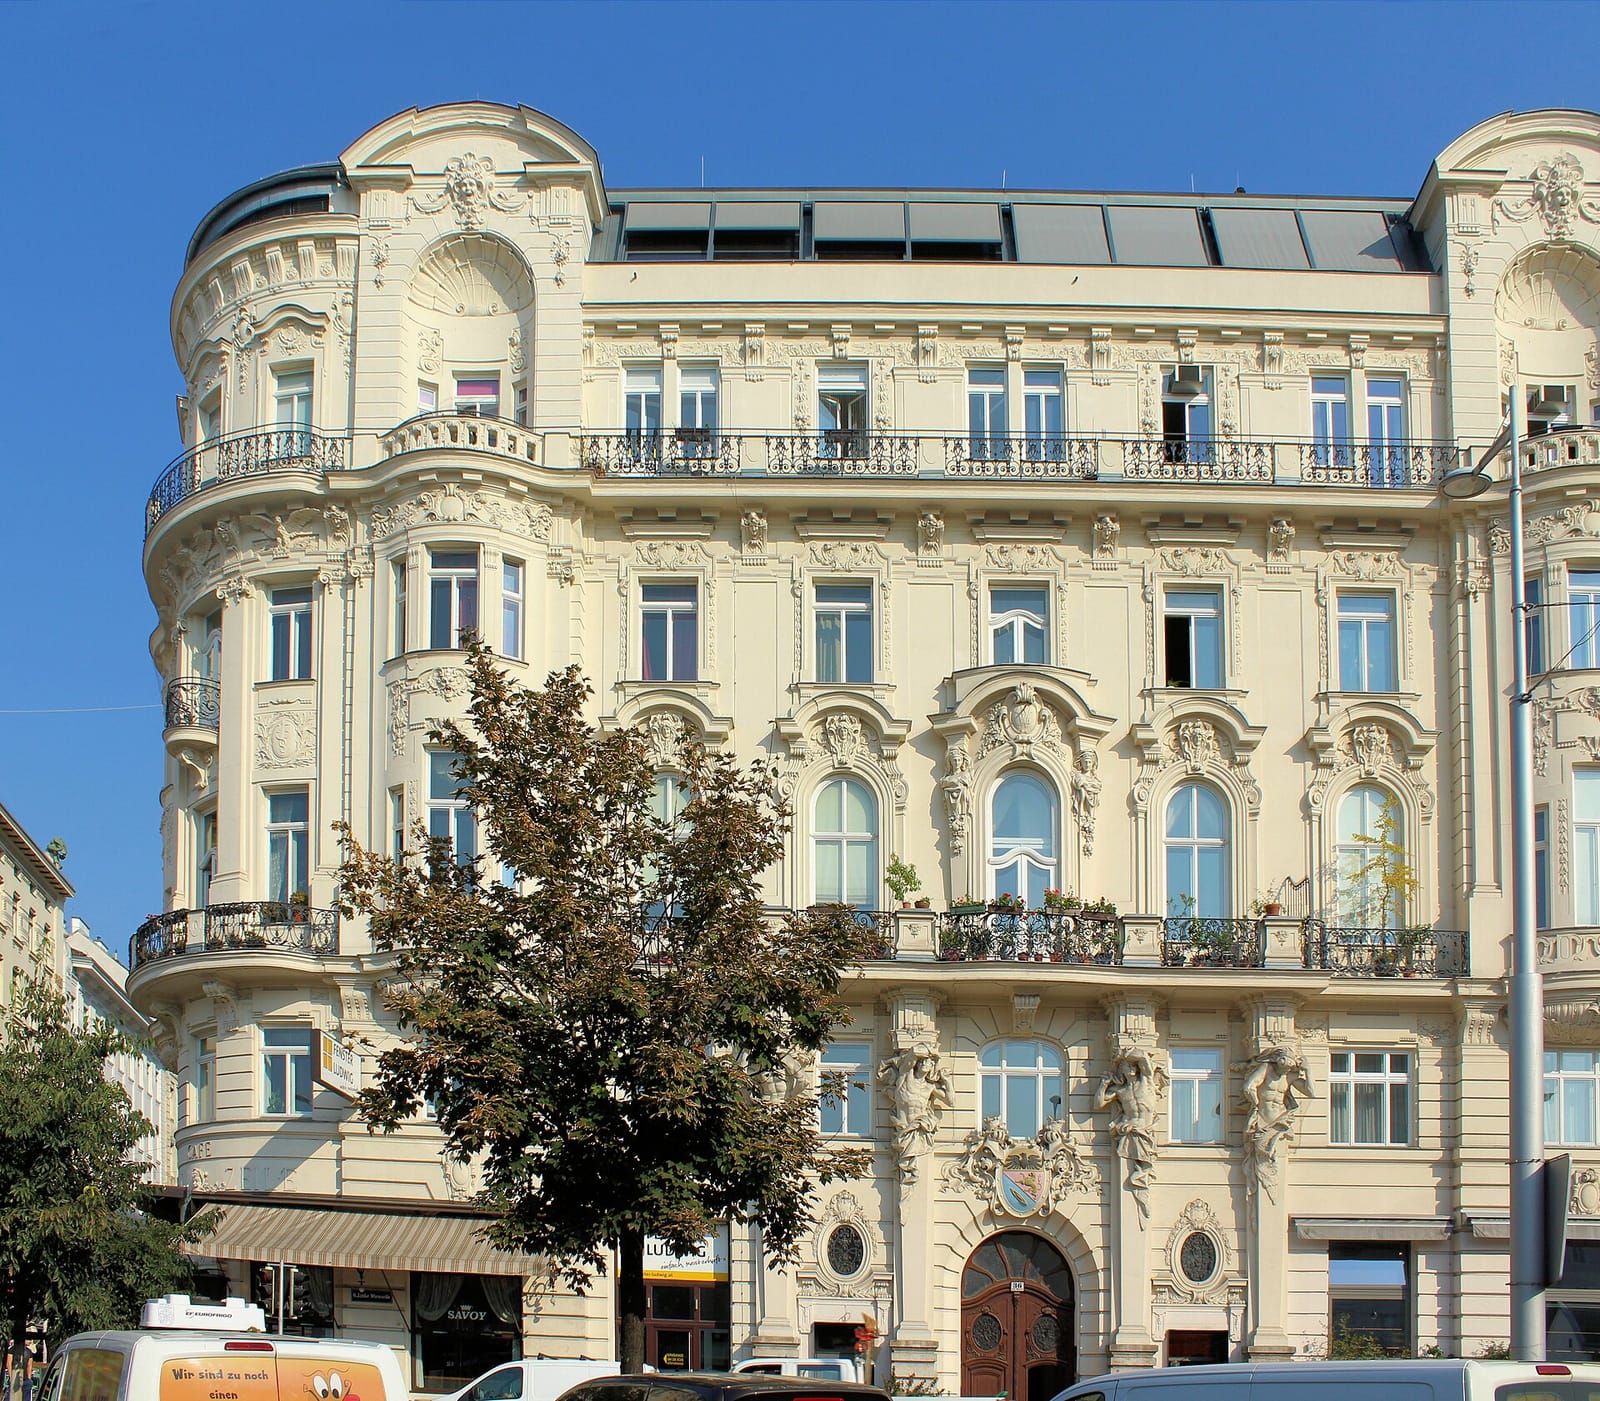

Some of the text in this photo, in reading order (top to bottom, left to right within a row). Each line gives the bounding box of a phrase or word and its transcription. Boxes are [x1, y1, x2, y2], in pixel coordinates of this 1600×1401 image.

[333, 1043, 353, 1066] FENSTER
[333, 1062, 354, 1085] LUDWIG
[647, 1243, 706, 1257] LUDG
[447, 1310, 487, 1320] SAVOY
[172, 1368, 269, 1380] Wir sind zu noch
[209, 1389, 238, 1400] einen
